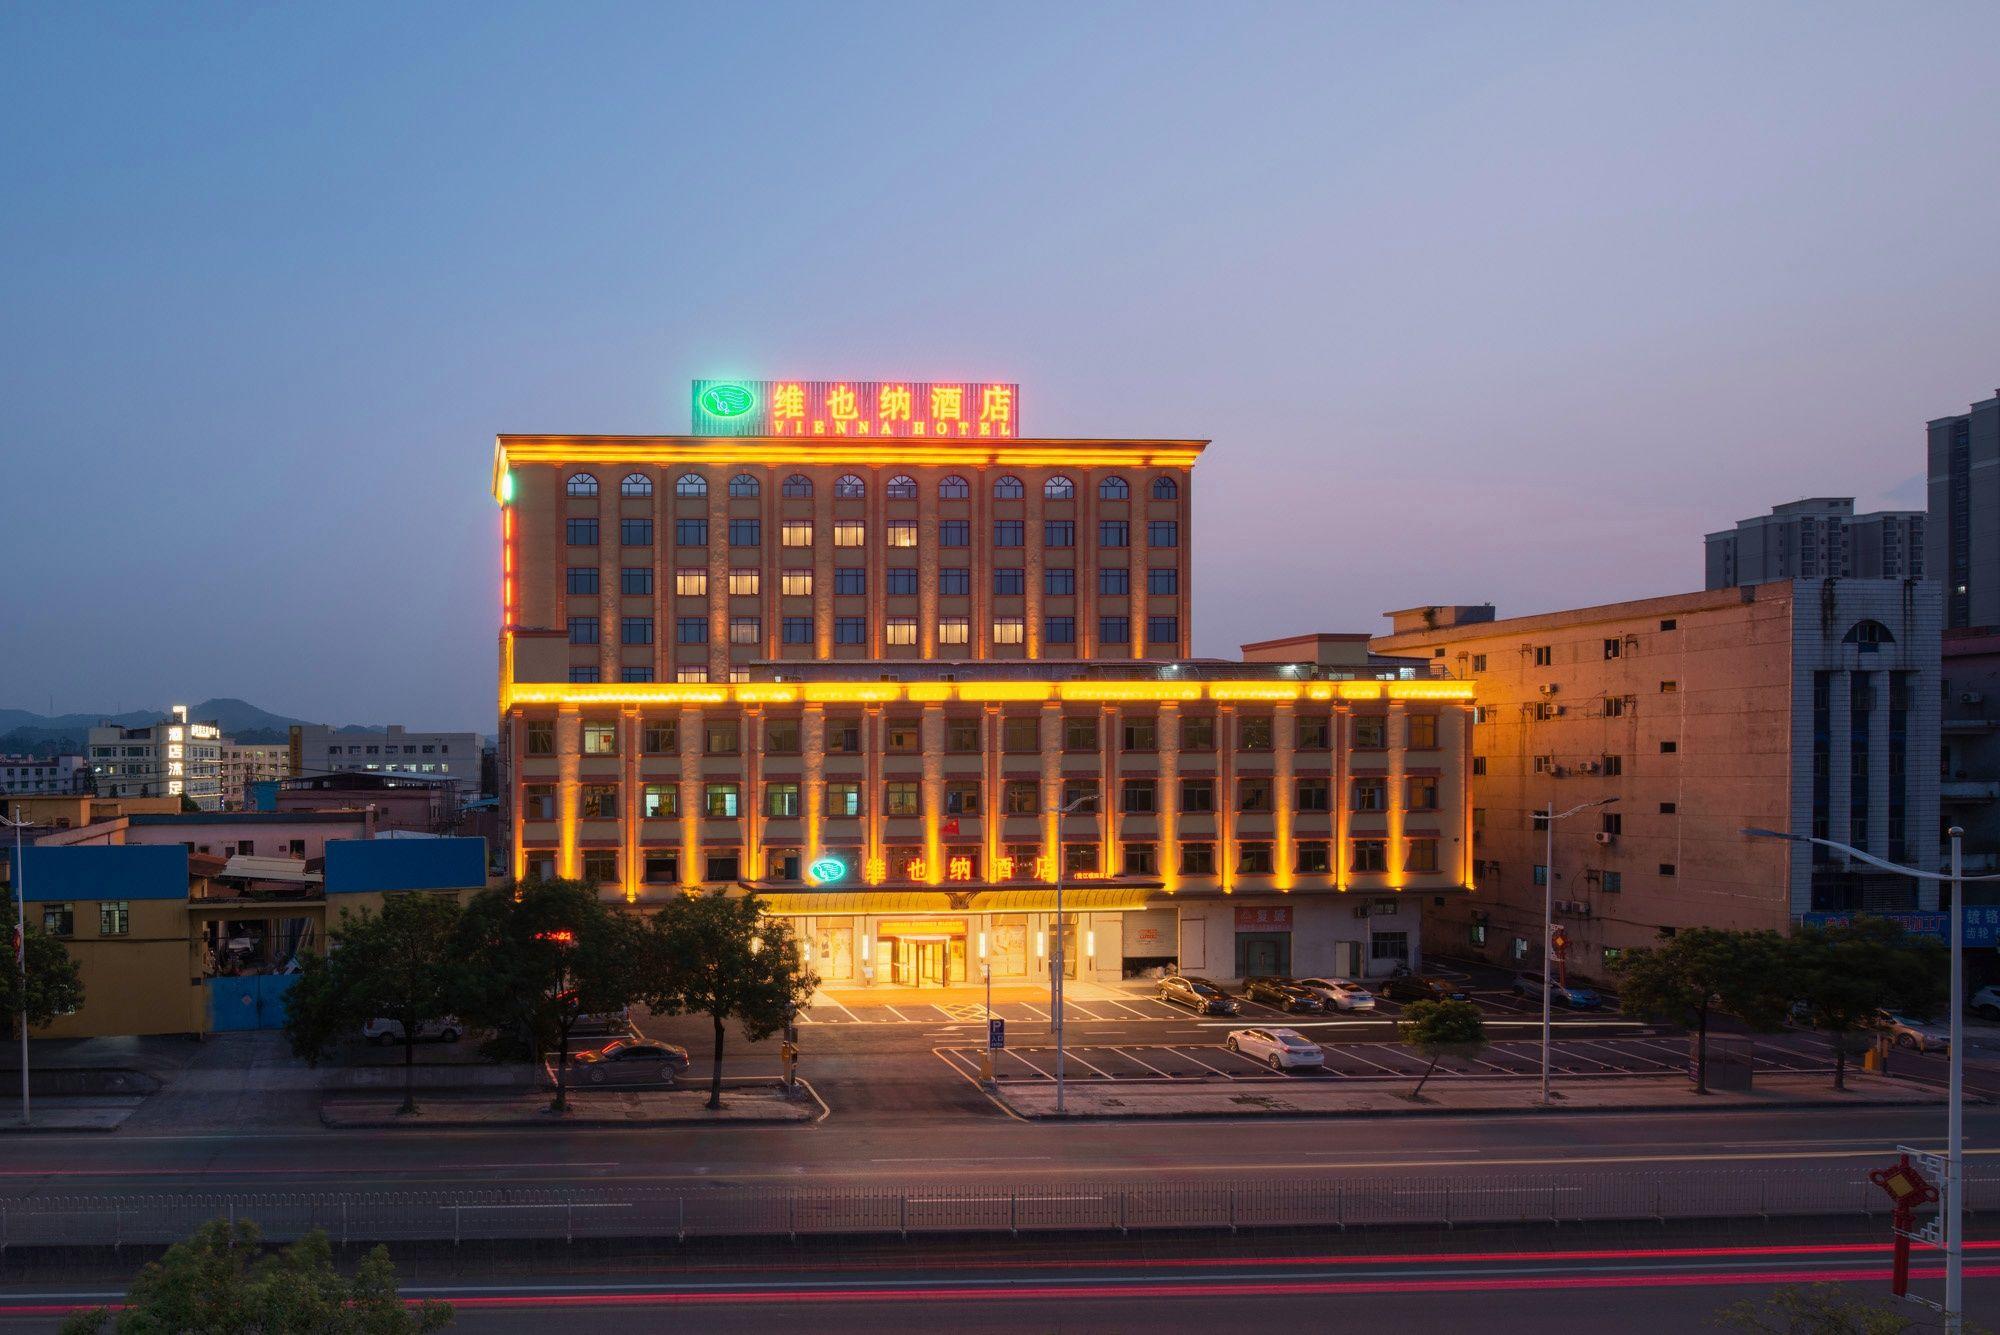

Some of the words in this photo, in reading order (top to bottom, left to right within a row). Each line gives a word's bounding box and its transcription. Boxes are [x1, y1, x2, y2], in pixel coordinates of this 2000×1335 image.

[773, 384, 1012, 421] 维也纳酒店
[773, 421, 893, 436] VIENNA
[913, 421, 1012, 436] HOTEL
[865, 855, 1058, 882] 维也纳酒店
[992, 1020, 1002, 1032] P
